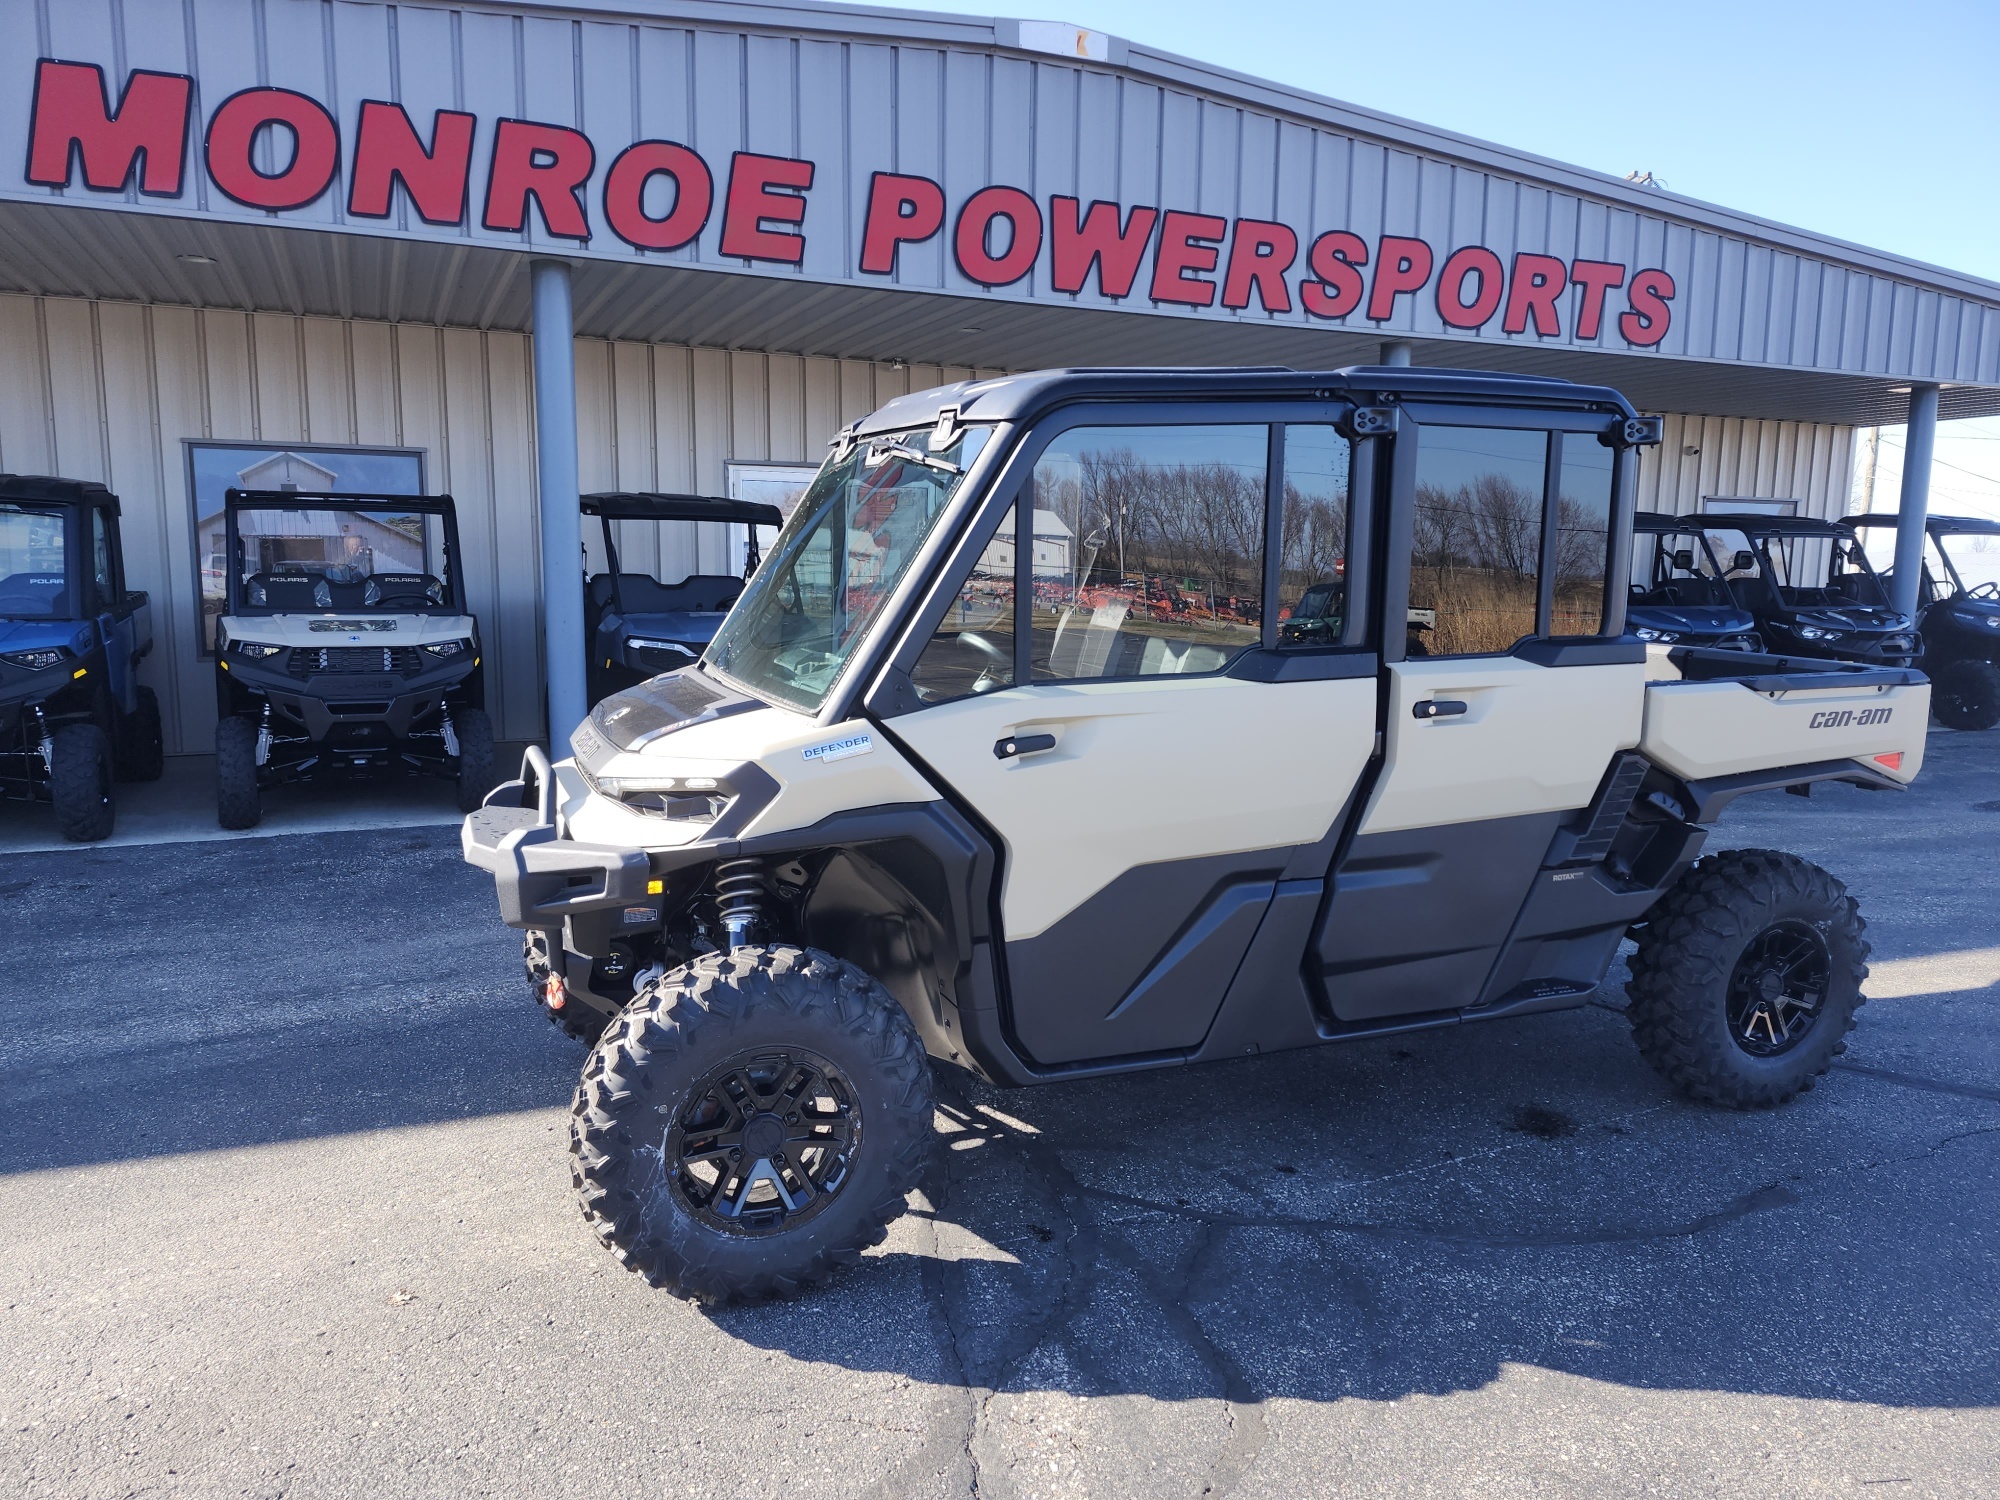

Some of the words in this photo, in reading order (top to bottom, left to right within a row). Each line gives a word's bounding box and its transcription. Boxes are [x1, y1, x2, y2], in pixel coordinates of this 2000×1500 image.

[25, 58, 816, 264] MONROE
[859, 171, 1677, 347] POWERSPORTS
[1809, 707, 1893, 729] can-am
[804, 736, 869, 758] DEFENDER
[1552, 872, 1575, 882] ROTAX
